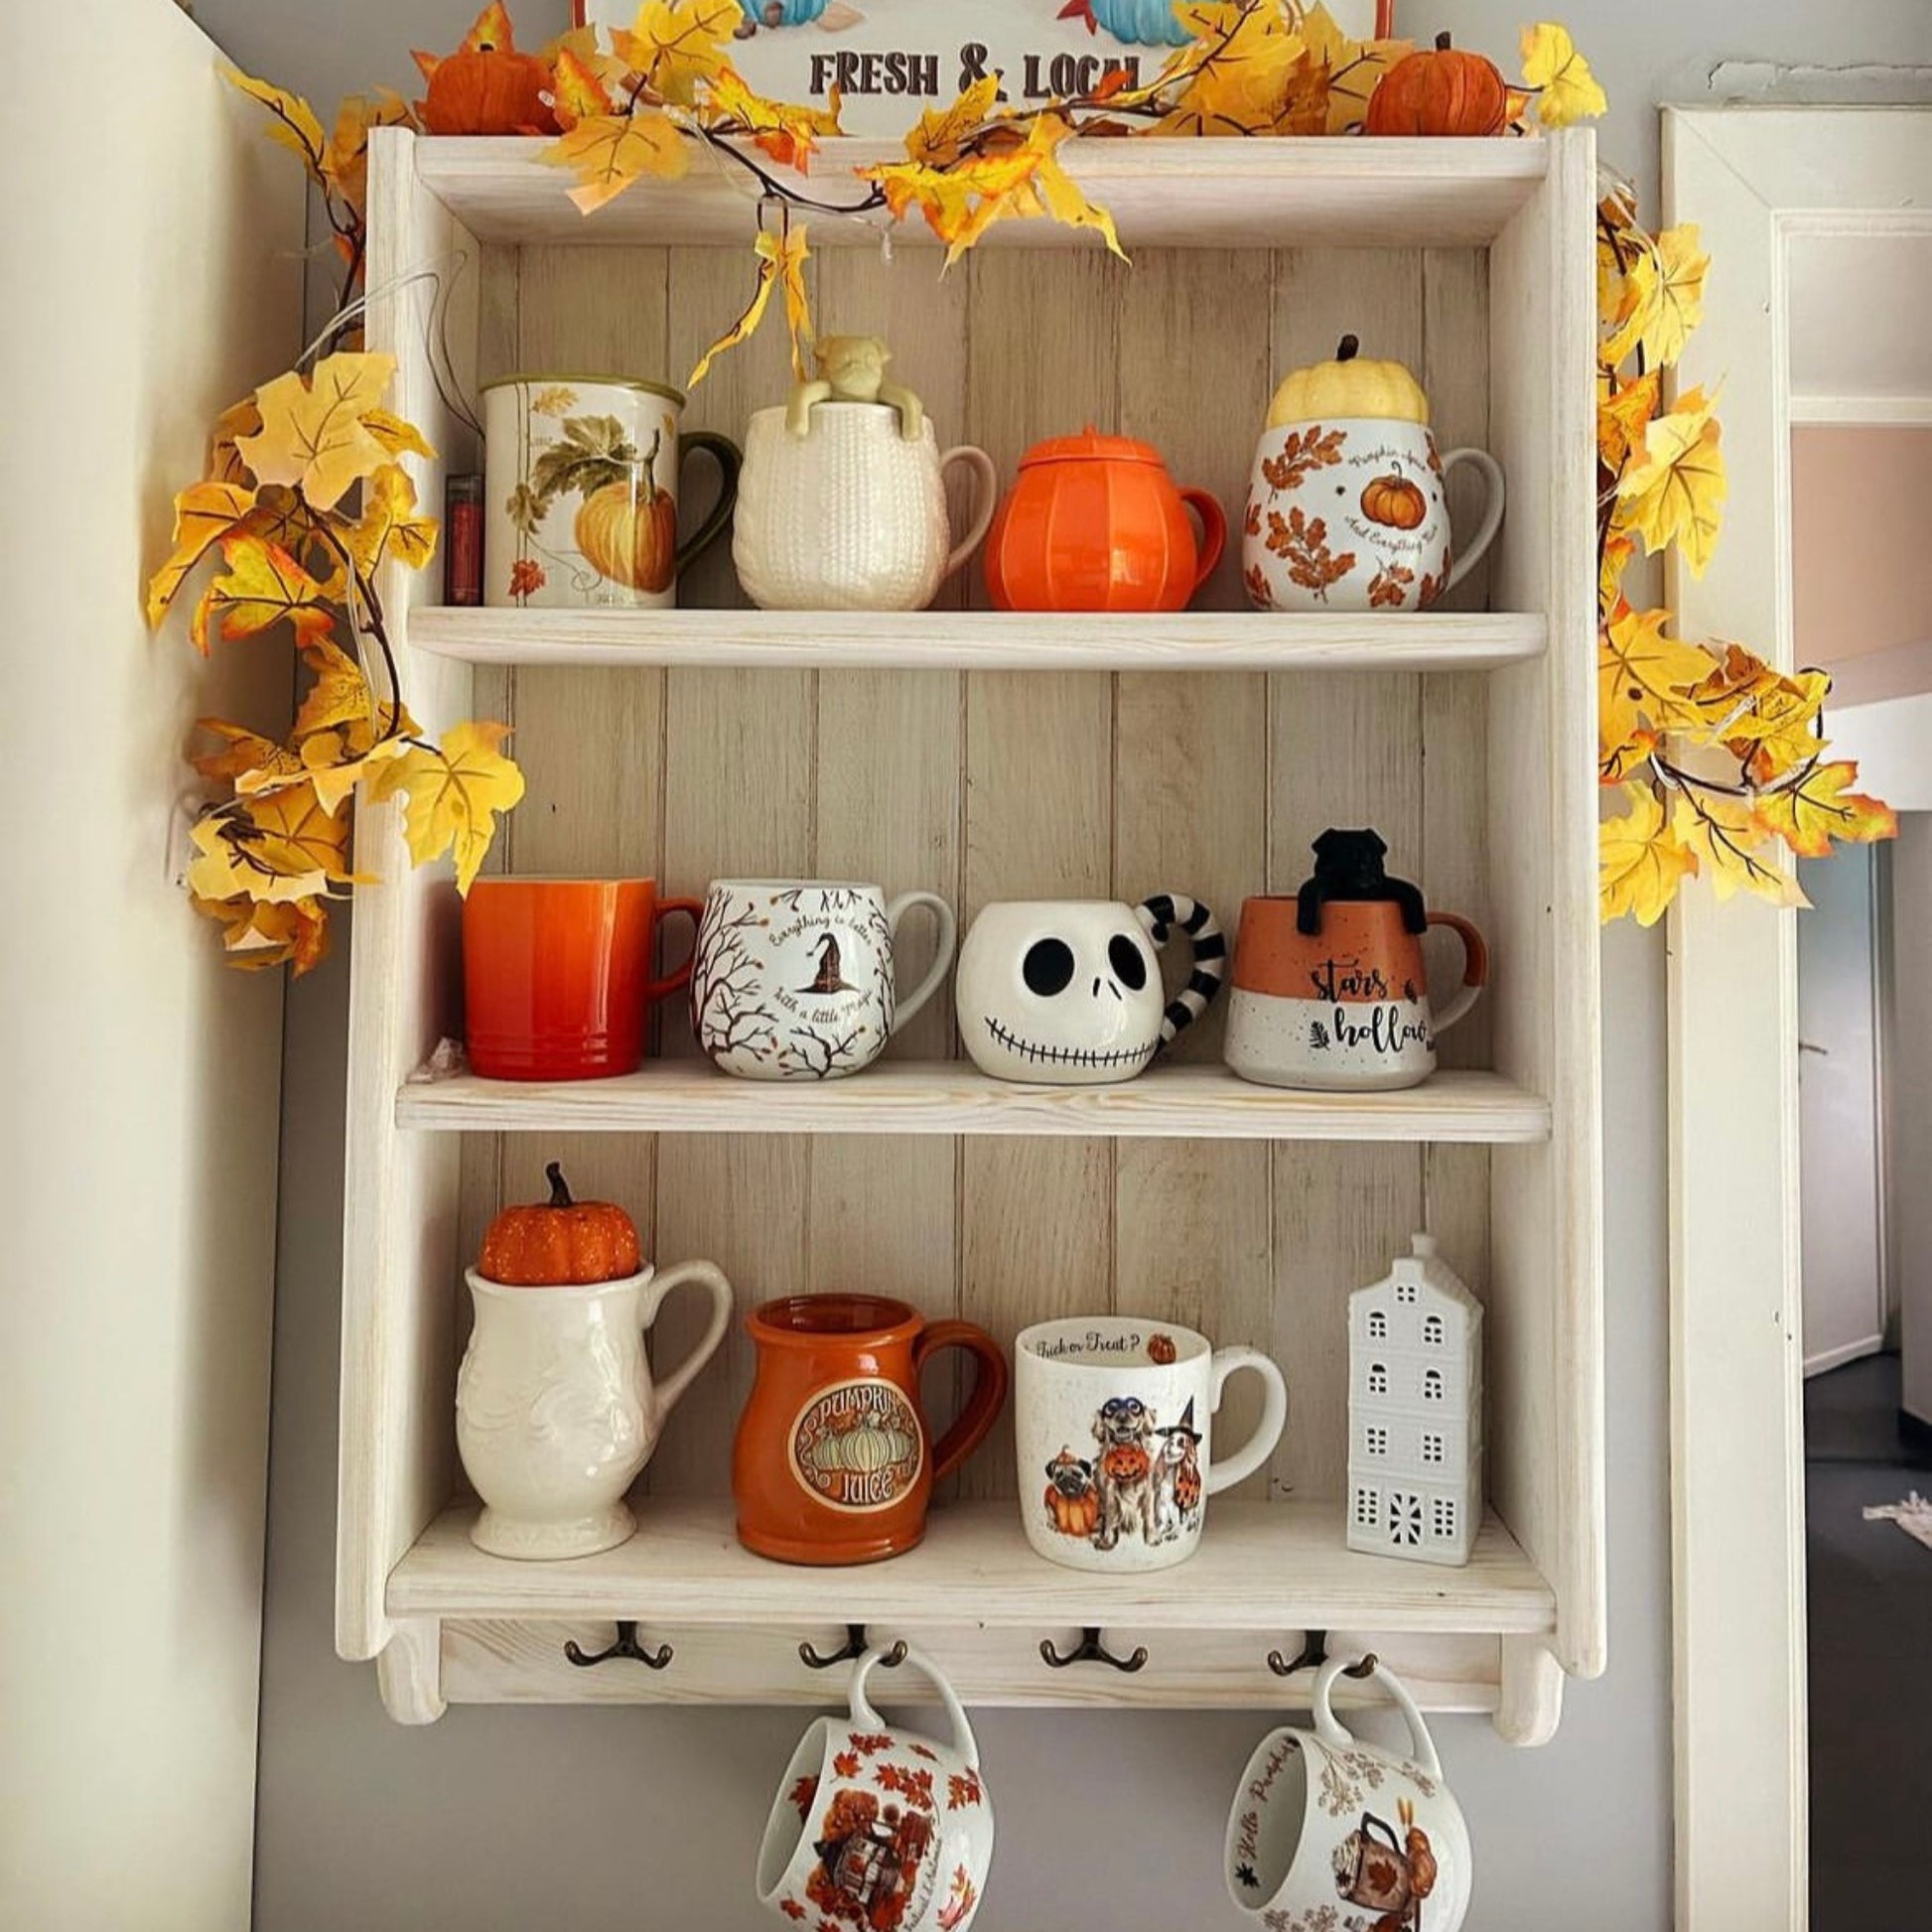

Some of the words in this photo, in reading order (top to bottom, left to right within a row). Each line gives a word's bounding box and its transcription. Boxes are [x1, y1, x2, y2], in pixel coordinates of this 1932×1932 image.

[810, 51, 938, 96] FRESH
[959, 43, 1008, 101] &
[768, 913, 830, 947] Everything
[1311, 958, 1388, 1003] stars
[818, 1385, 898, 1426] PUMPKIN
[843, 1466, 895, 1504] JUICE
